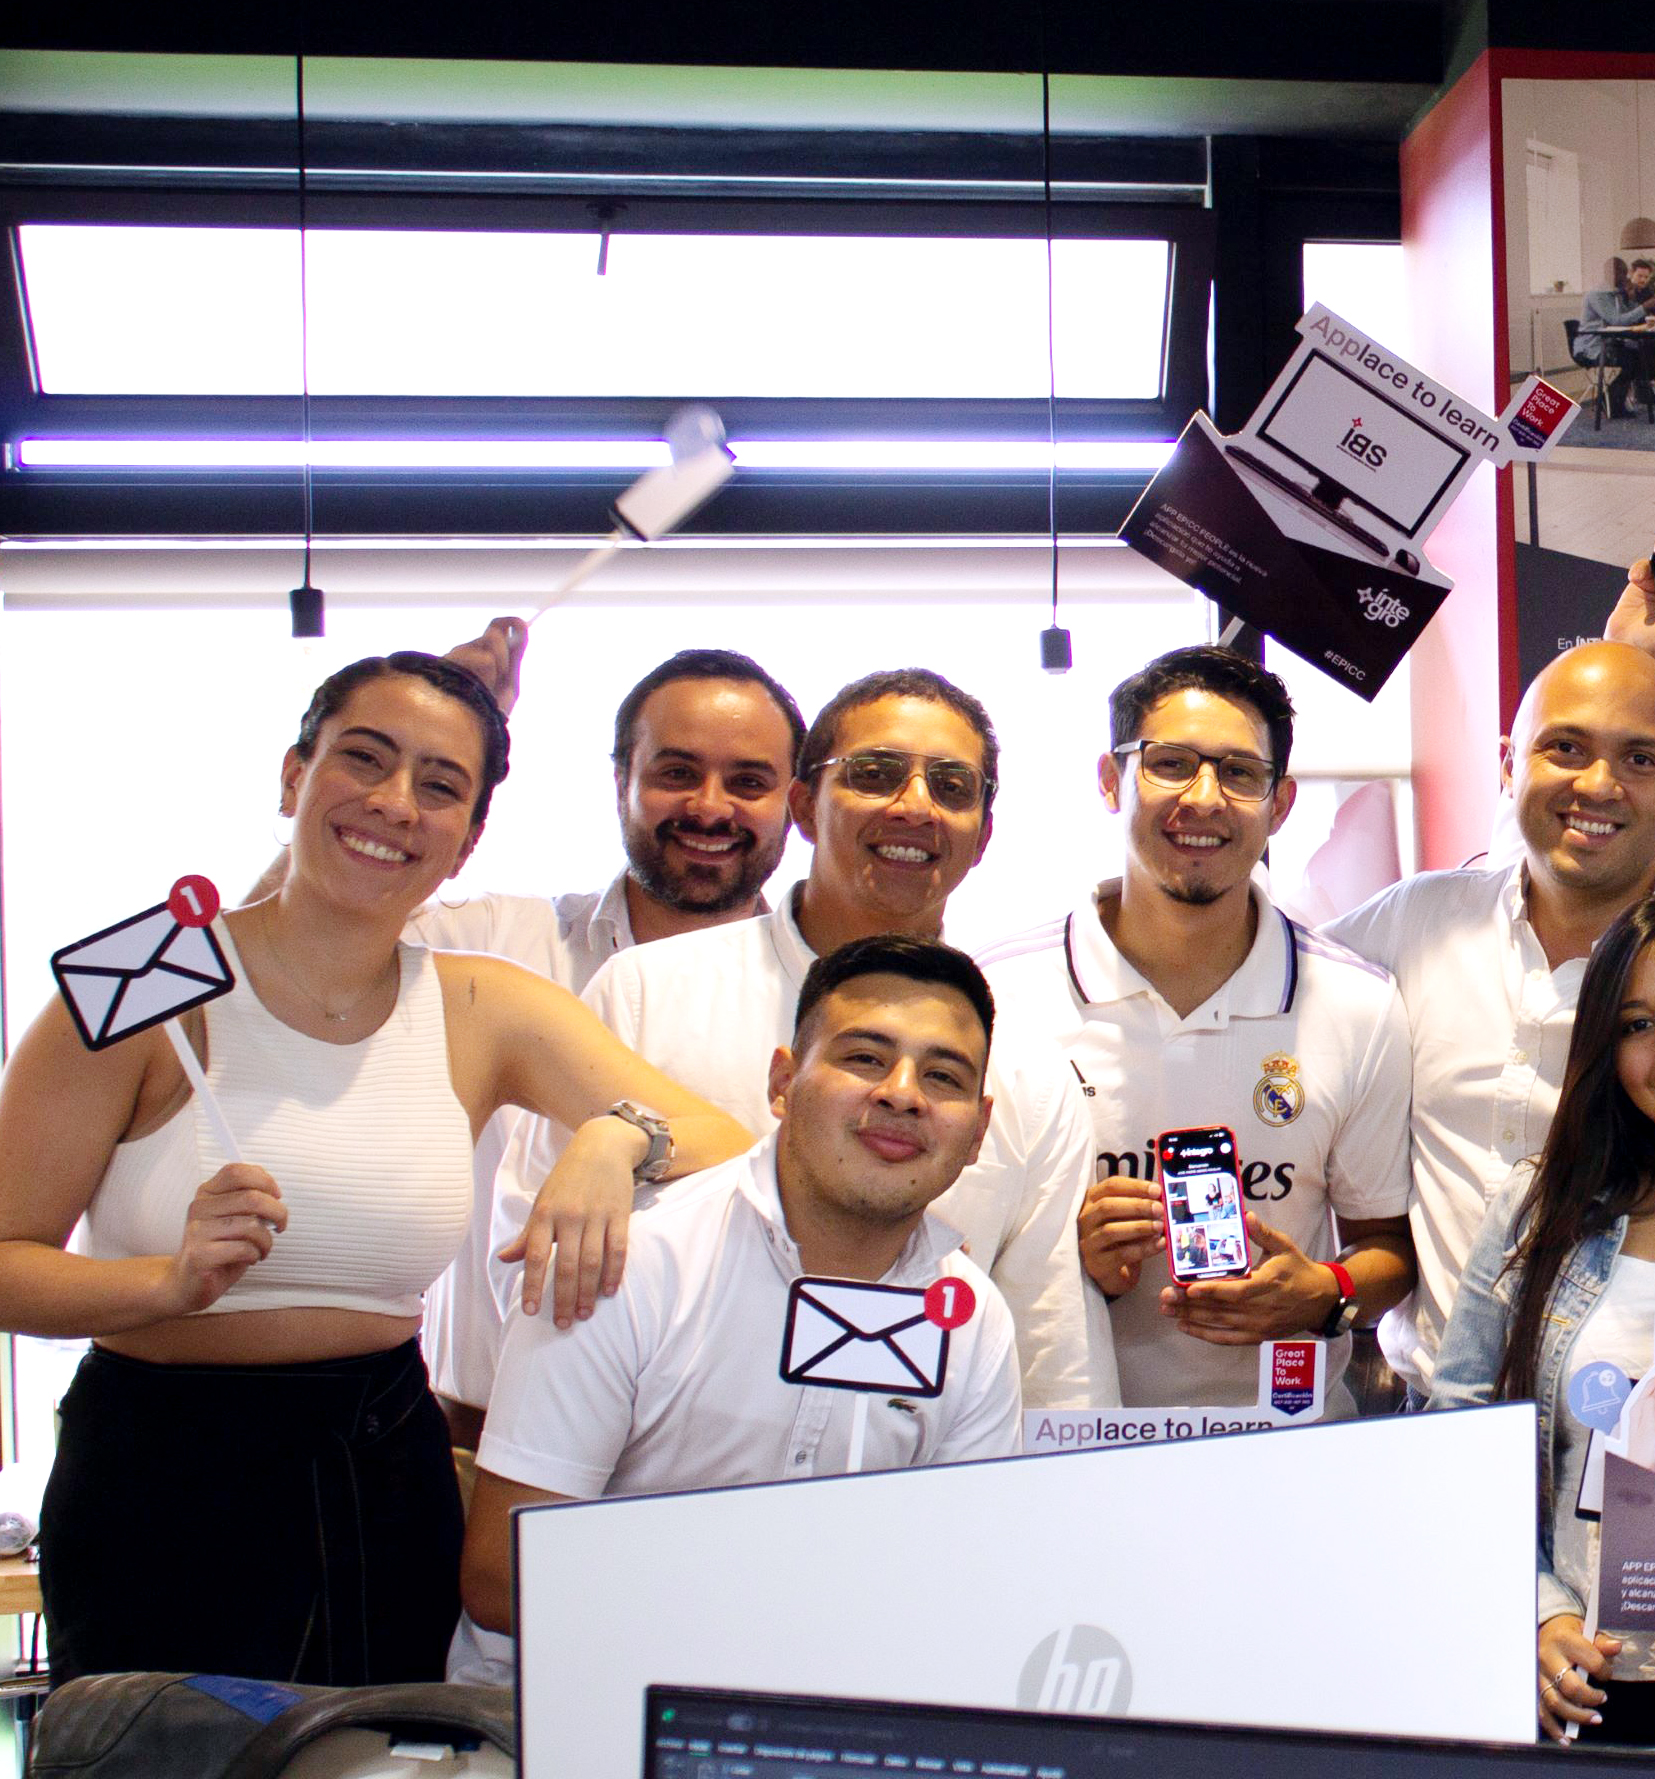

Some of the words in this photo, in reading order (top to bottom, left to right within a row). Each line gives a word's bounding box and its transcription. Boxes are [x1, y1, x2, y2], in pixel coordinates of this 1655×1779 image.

[1310, 316, 1408, 389] Applace
[1411, 381, 1436, 408] to
[1439, 399, 1500, 452] learn
[1527, 401, 1536, 412] To
[1532, 395, 1555, 414] Place
[1535, 388, 1561, 409] Great
[1161, 503, 1177, 516] APP
[1200, 528, 1230, 552] PEOPLE
[1558, 637, 1573, 650] En
[1323, 650, 1366, 681] #EPICC
[179, 885, 203, 915] 1
[942, 1286, 955, 1319] 1
[1275, 1349, 1305, 1358] Great
[1276, 1358, 1305, 1367] Place
[1276, 1367, 1287, 1376] To
[1035, 1417, 1157, 1446] Applace
[1164, 1417, 1193, 1440] to
[1622, 1561, 1643, 1572] APP
[1621, 1589, 1628, 1599] y
